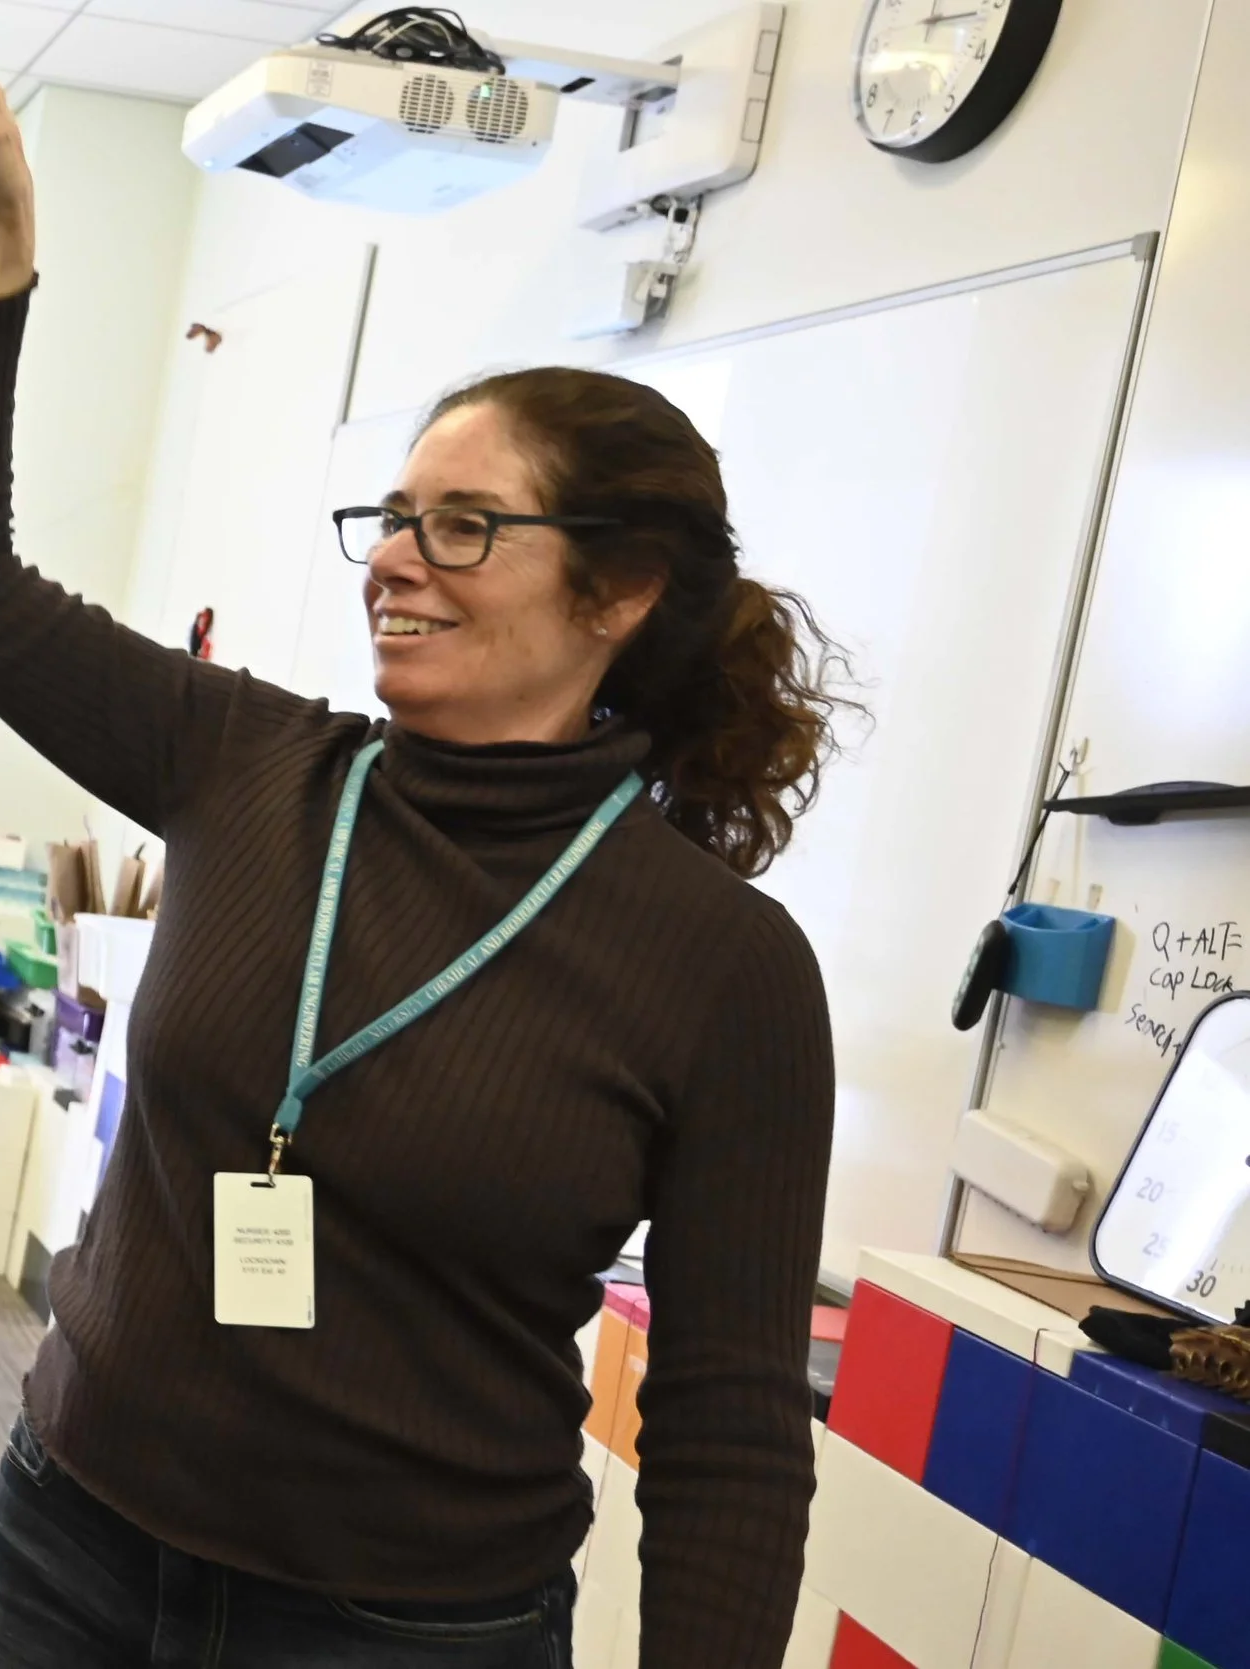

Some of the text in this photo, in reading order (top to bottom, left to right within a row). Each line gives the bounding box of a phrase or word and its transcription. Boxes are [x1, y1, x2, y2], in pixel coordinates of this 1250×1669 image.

[974, 38, 986, 62] 4
[866, 82, 878, 108] 8
[882, 108, 894, 135] 7
[425, 955, 480, 1001] CHEMICAL
[479, 934, 502, 958] AND
[558, 818, 607, 874] ENGINEERING
[297, 986, 318, 1067] ENGINEERING
[1136, 1177, 1164, 1203] 20
[1142, 1232, 1171, 1258] 25
[1186, 1270, 1216, 1298] 30
